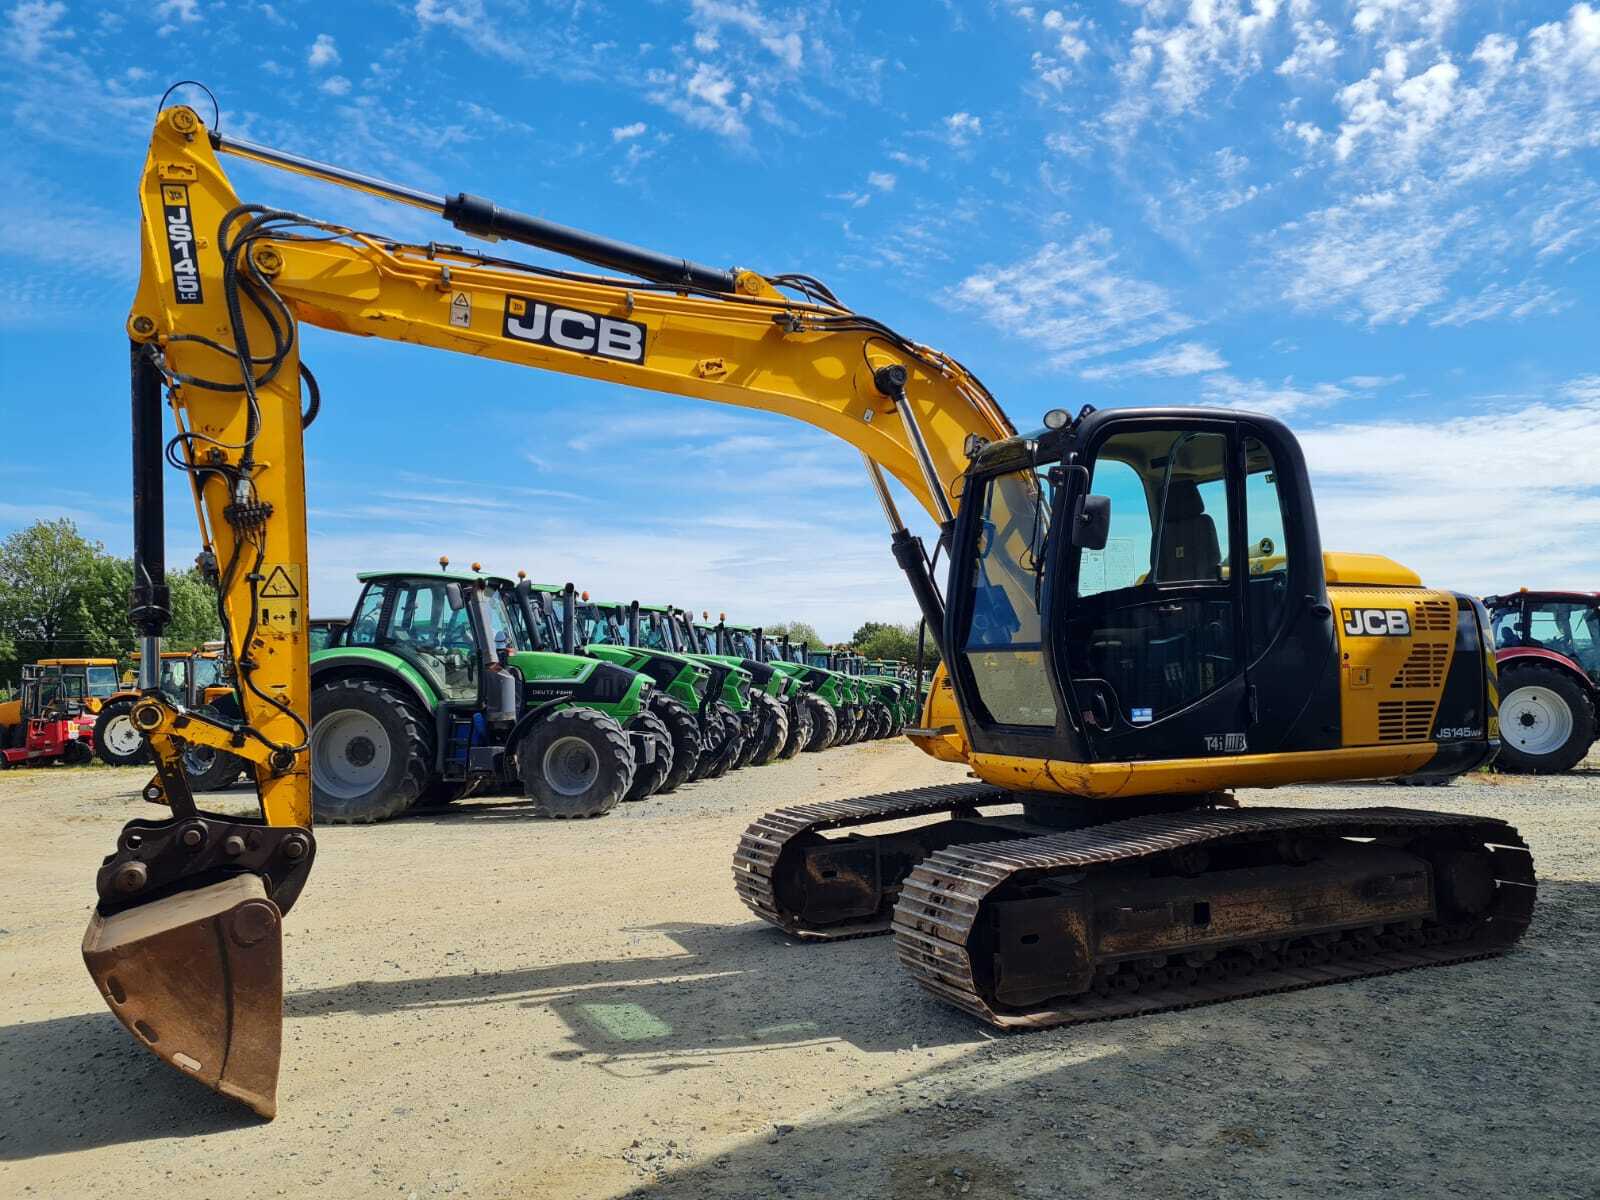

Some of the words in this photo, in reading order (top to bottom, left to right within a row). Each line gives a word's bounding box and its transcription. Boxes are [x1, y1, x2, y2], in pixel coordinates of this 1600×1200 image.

[168, 207, 199, 292] JS145
[507, 303, 642, 360] JCB
[1344, 608, 1410, 635] JCB
